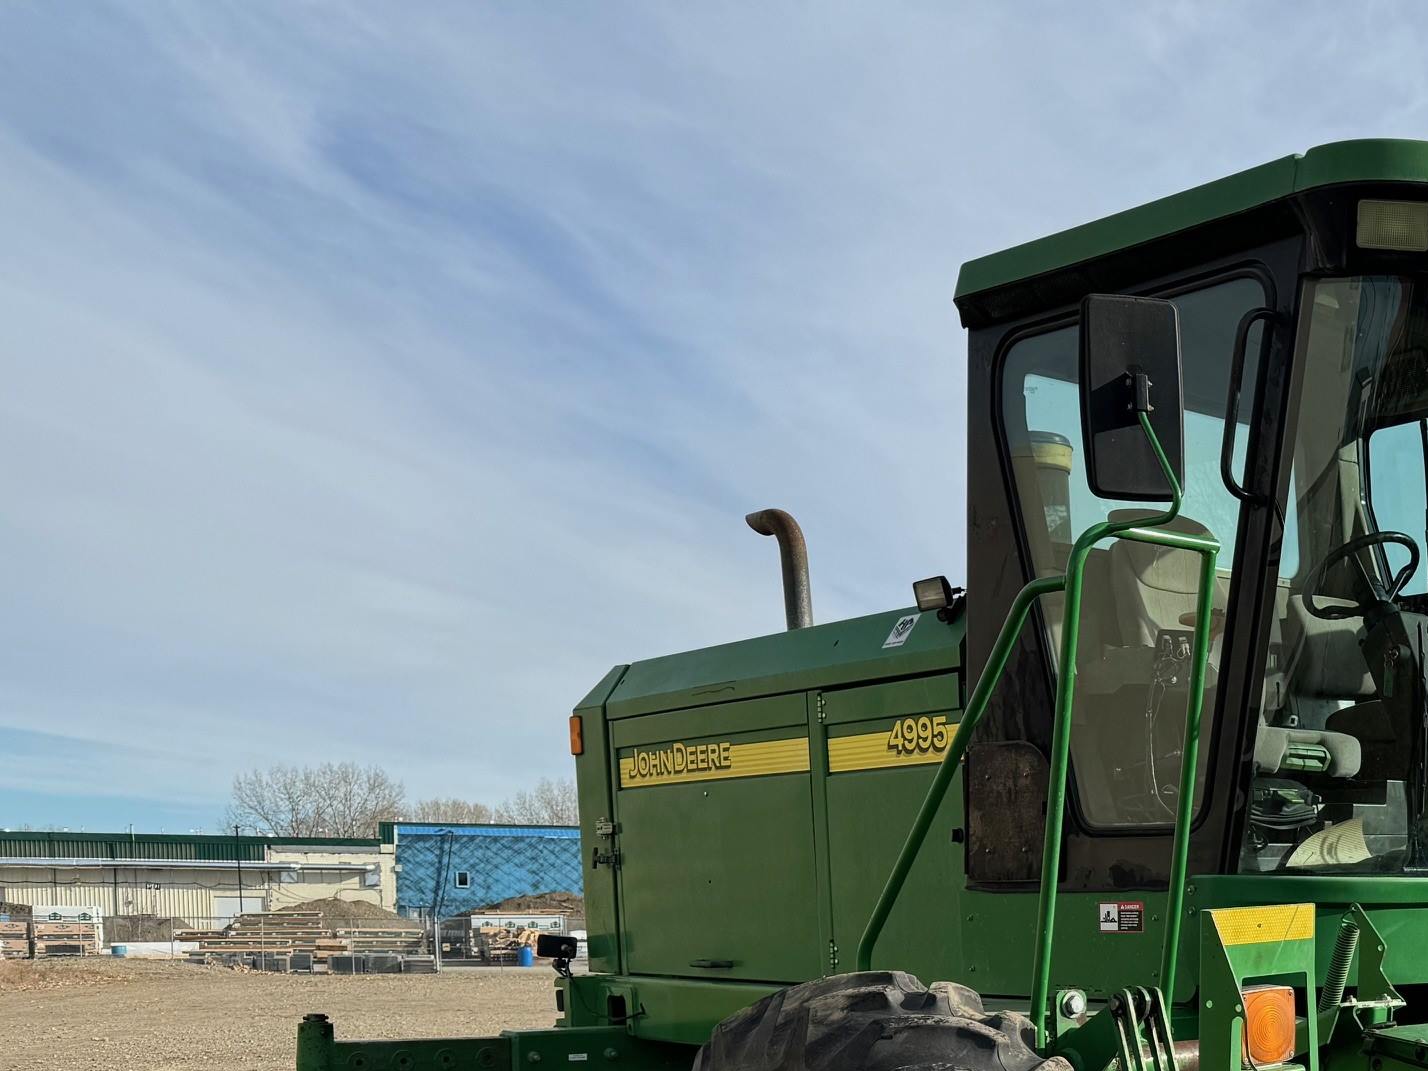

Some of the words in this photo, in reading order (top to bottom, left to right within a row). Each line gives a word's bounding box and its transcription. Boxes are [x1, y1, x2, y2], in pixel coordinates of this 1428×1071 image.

[888, 715, 948, 754] 4995
[629, 748, 673, 777] JOHN
[672, 742, 732, 772] DEERE
